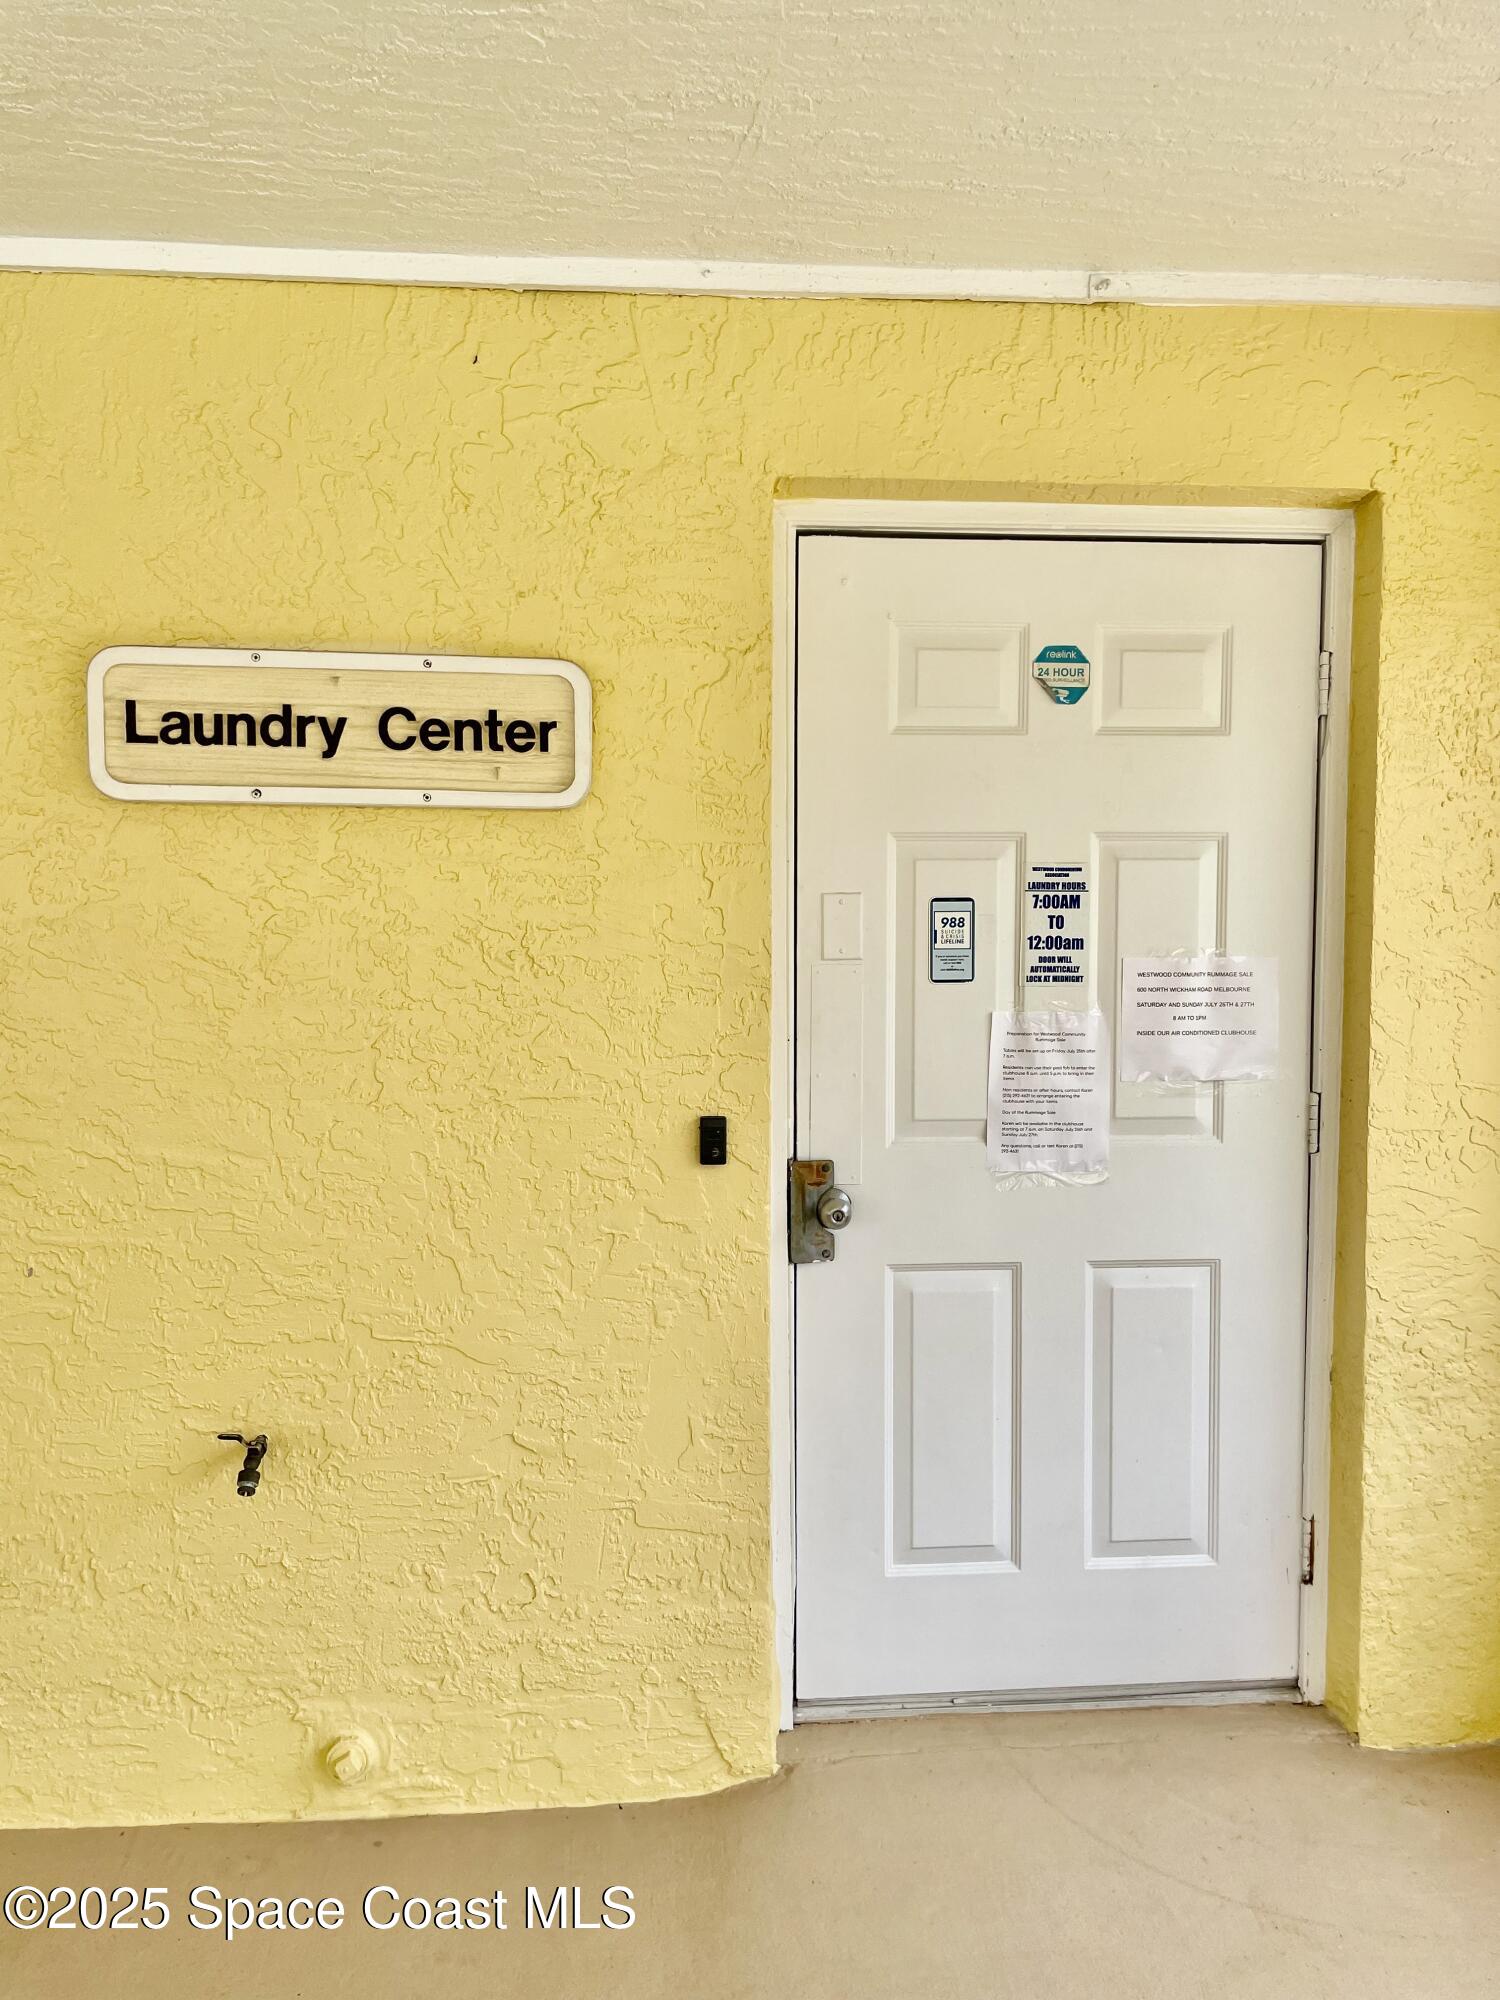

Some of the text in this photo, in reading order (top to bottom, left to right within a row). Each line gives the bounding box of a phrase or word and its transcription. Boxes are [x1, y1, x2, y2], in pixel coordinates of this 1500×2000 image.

[1038, 668, 1084, 676] 24 HOUR
[125, 700, 558, 759] Laundry Center
[1028, 882, 1086, 890] LAUNDRY HOURS
[1032, 894, 1080, 909] 7:00AM
[941, 917, 965, 928] 988
[1048, 915, 1064, 930] TO
[1027, 936, 1084, 950] 12:00am
